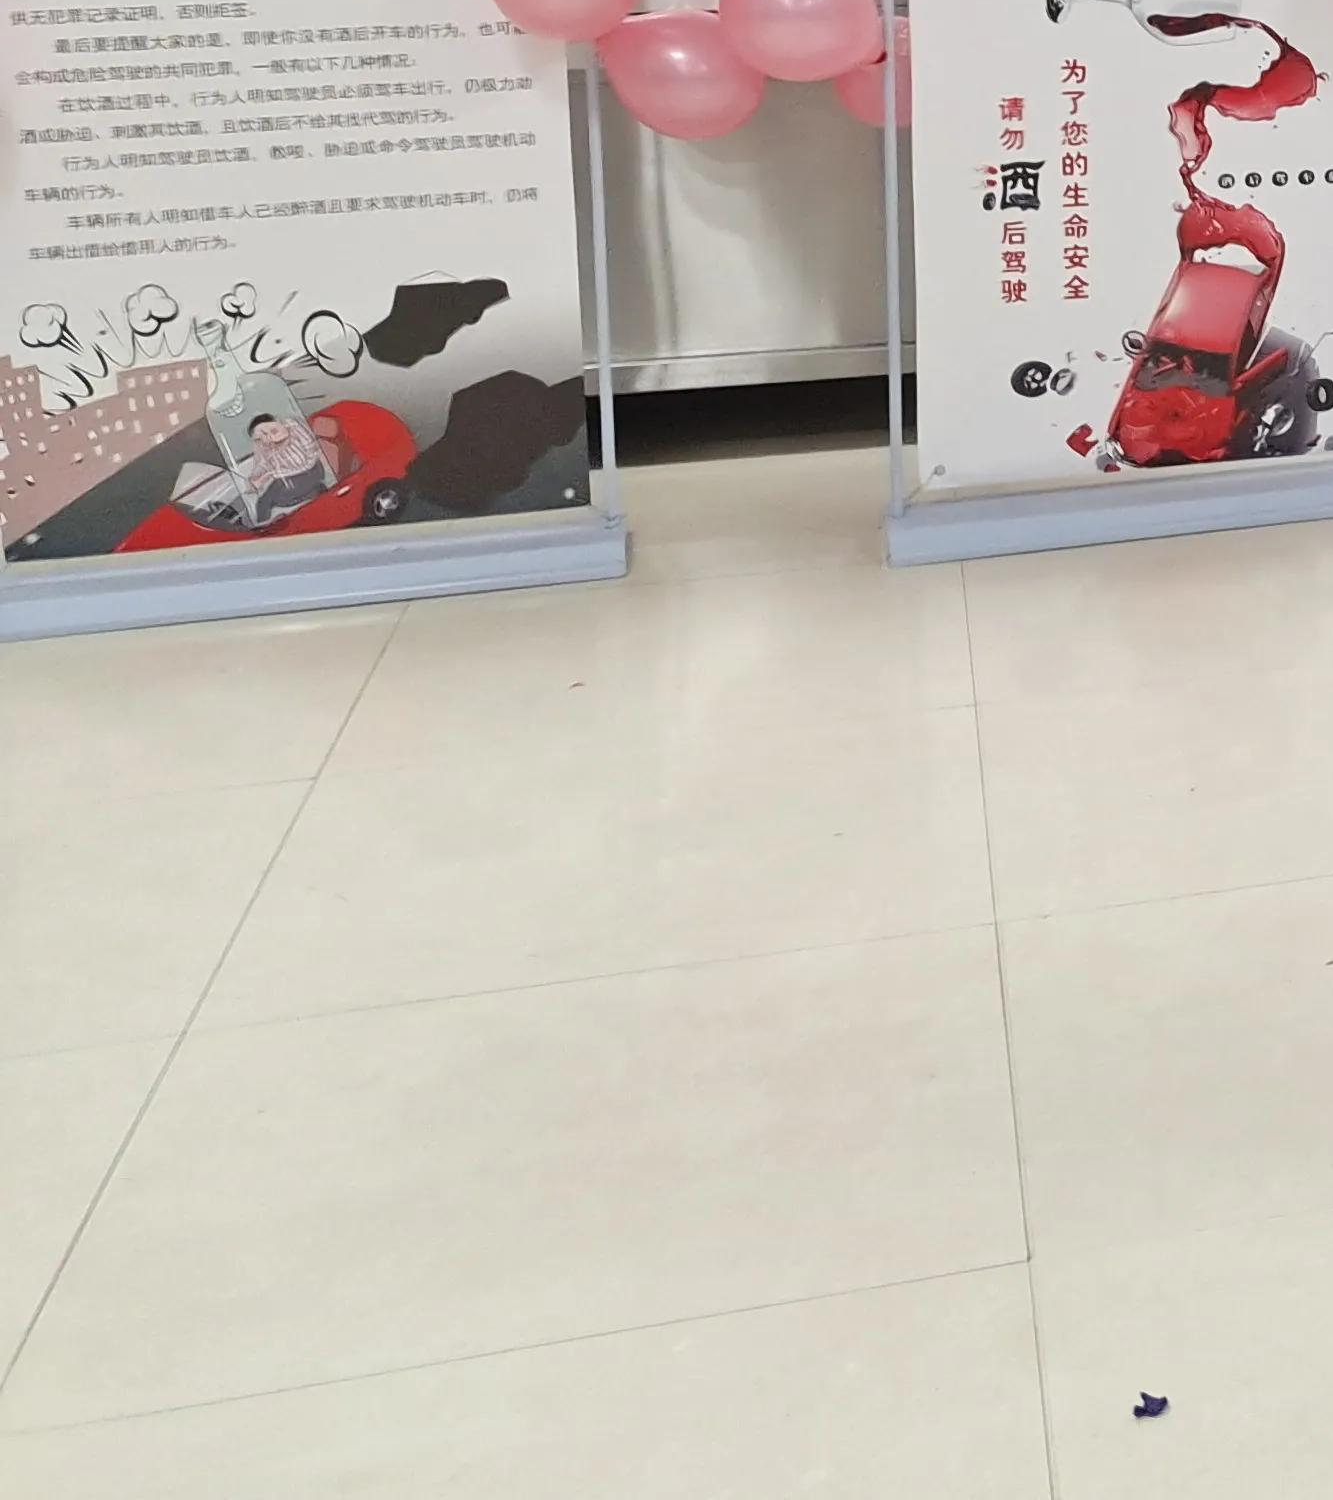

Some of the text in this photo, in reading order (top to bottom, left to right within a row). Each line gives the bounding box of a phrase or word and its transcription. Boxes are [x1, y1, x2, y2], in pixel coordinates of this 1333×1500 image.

[982, 97, 1046, 303] 请勿酒后驾驶
[1061, 59, 1089, 300] 为了您的生命安全
